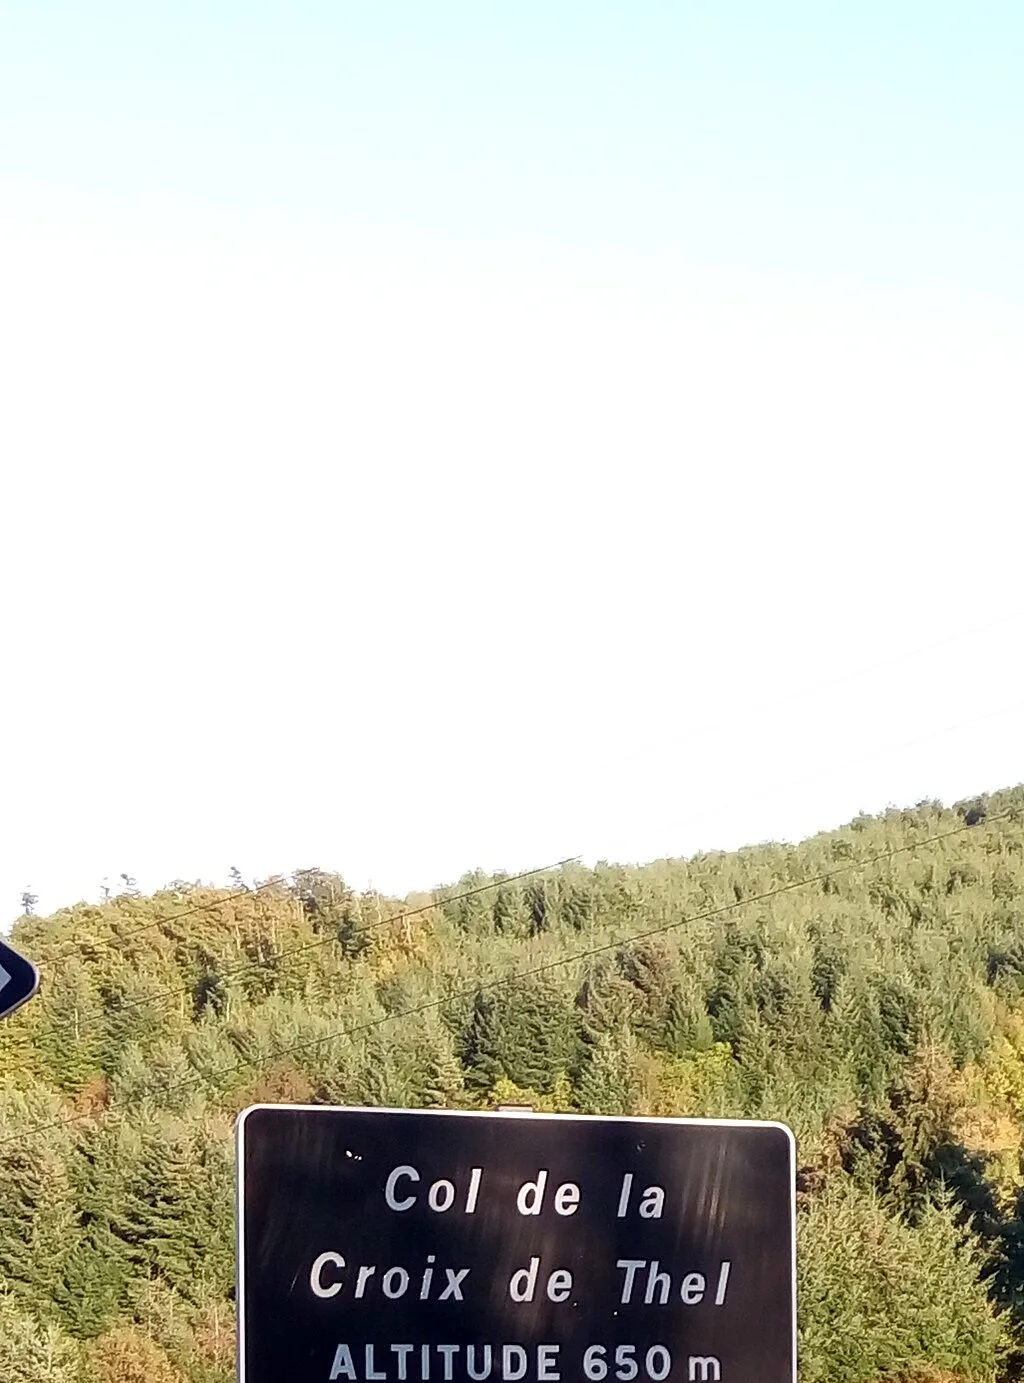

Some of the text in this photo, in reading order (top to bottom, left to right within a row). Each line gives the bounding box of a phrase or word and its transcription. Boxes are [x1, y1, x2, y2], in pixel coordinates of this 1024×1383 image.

[385, 1165, 666, 1219] Col de la
[310, 1251, 731, 1306] Croix de Thel
[329, 1344, 722, 1382] ALTITUDE 650 m
